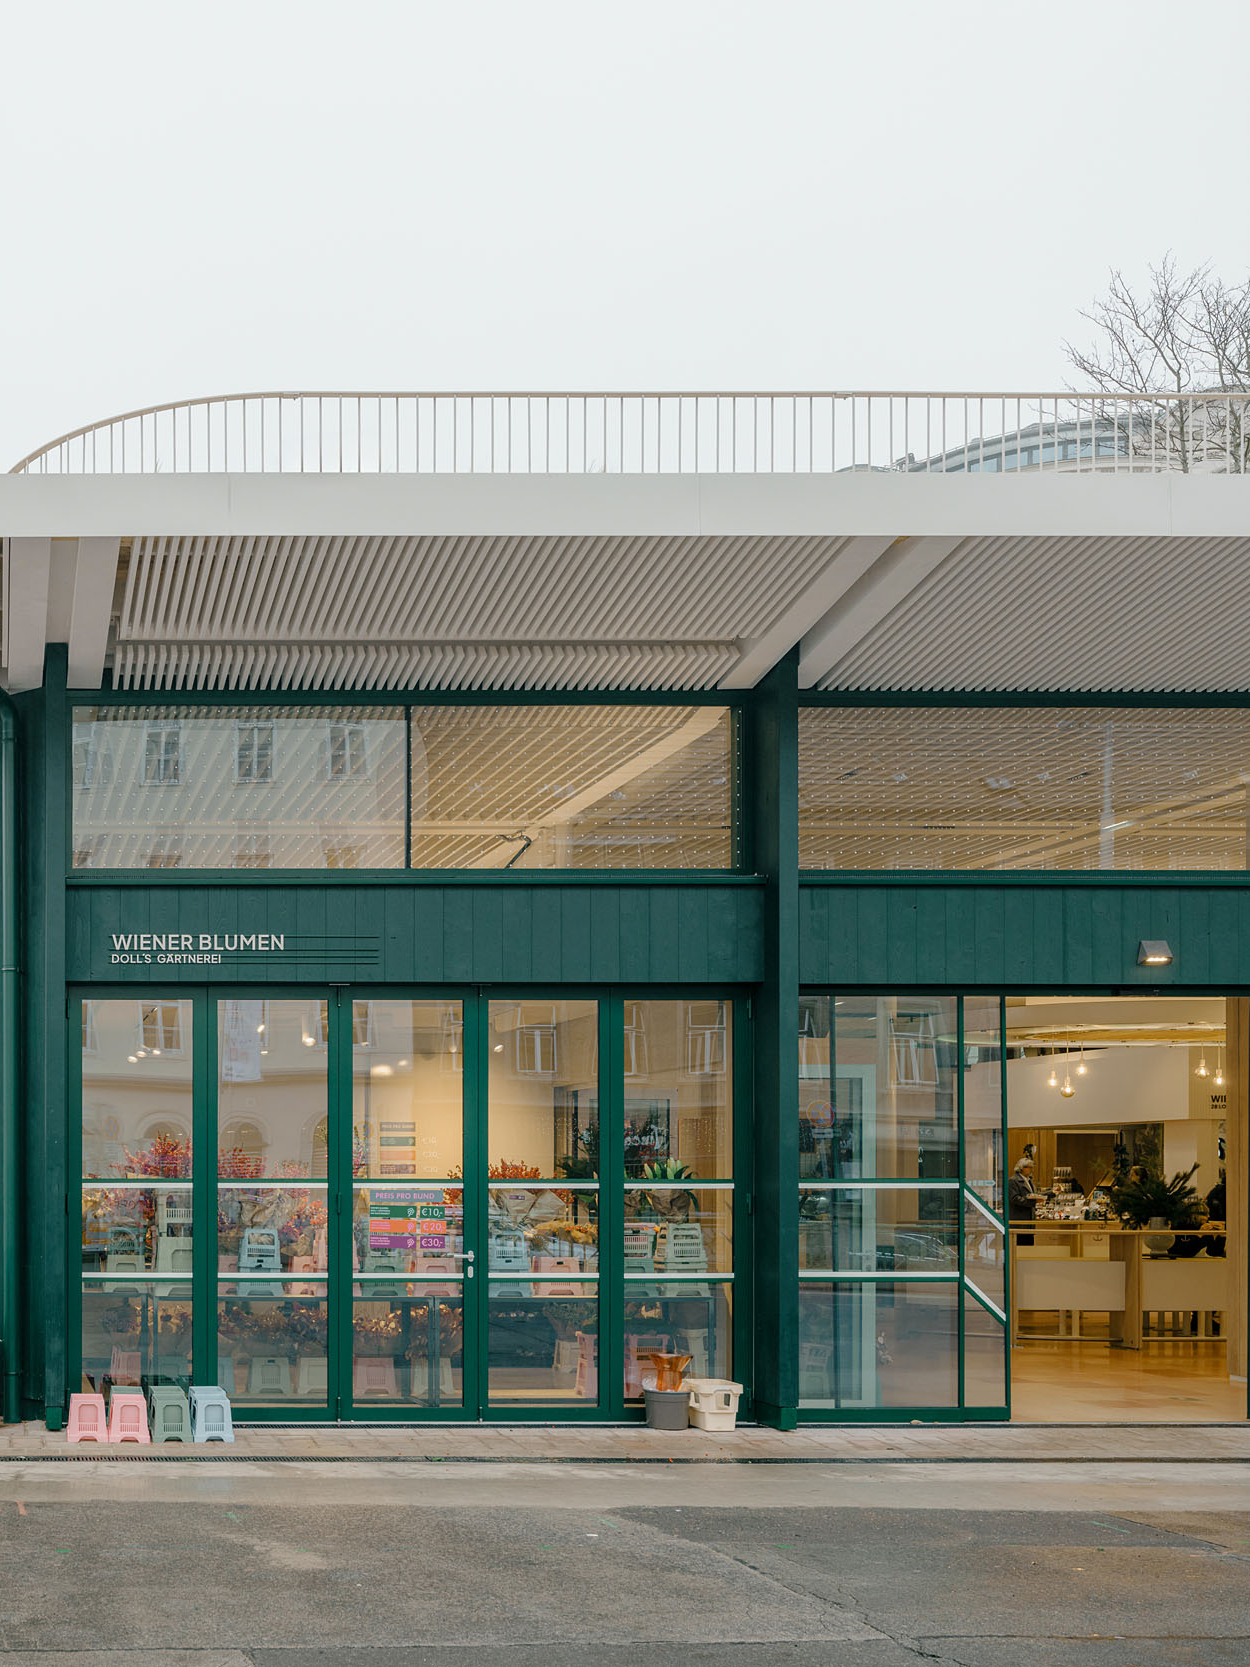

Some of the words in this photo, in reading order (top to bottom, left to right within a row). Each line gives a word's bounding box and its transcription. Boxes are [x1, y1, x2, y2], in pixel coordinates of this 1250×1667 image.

[112, 934, 194, 951] WIENER
[199, 934, 285, 951] BLUMEN
[157, 952, 222, 964] GÄRTNEREI
[375, 1192, 395, 1200] PREIS
[396, 1192, 411, 1200] PRO
[413, 1192, 435, 1200] BUND
[421, 1207, 443, 1217] €10,-
[421, 1238, 443, 1248] €30,-
